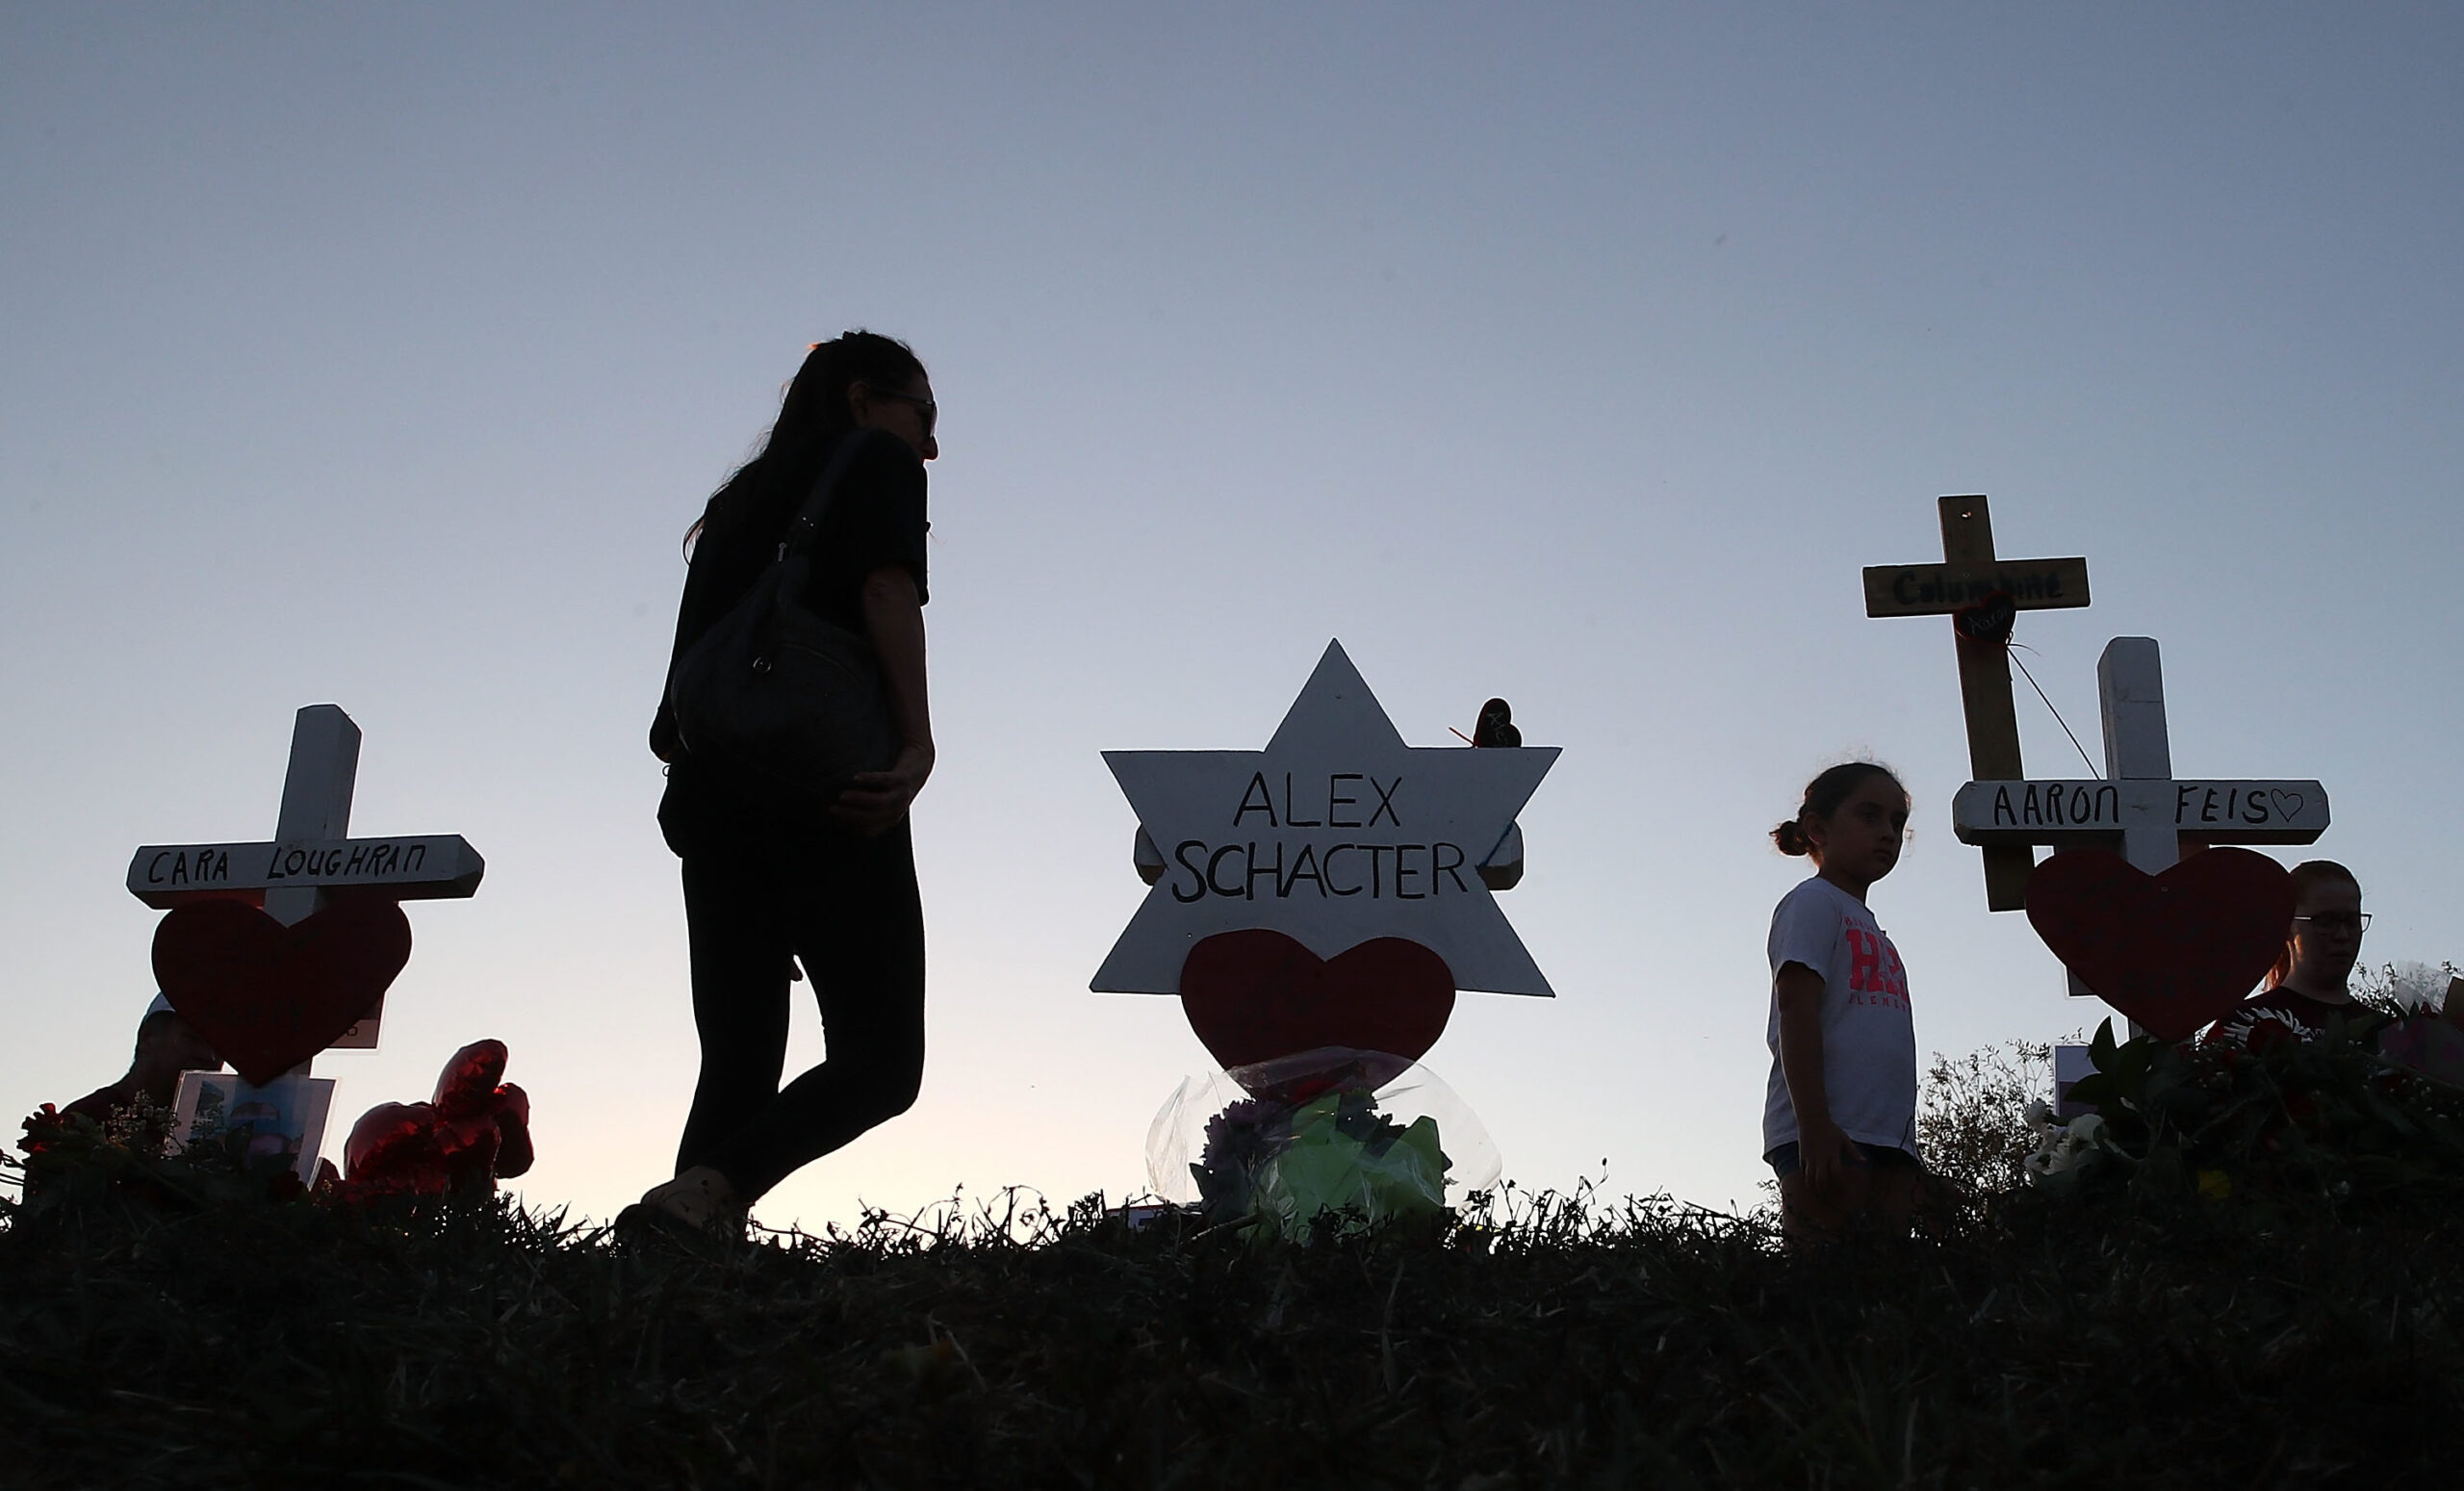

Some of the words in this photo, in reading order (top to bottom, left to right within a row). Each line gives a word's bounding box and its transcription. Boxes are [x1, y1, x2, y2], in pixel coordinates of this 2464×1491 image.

[1232, 770, 1402, 828] ALEX
[1993, 783, 2119, 827] AARON
[2174, 784, 2270, 825] FEIS
[147, 848, 228, 886] CARA
[1171, 839, 1469, 904] SCHACTER
